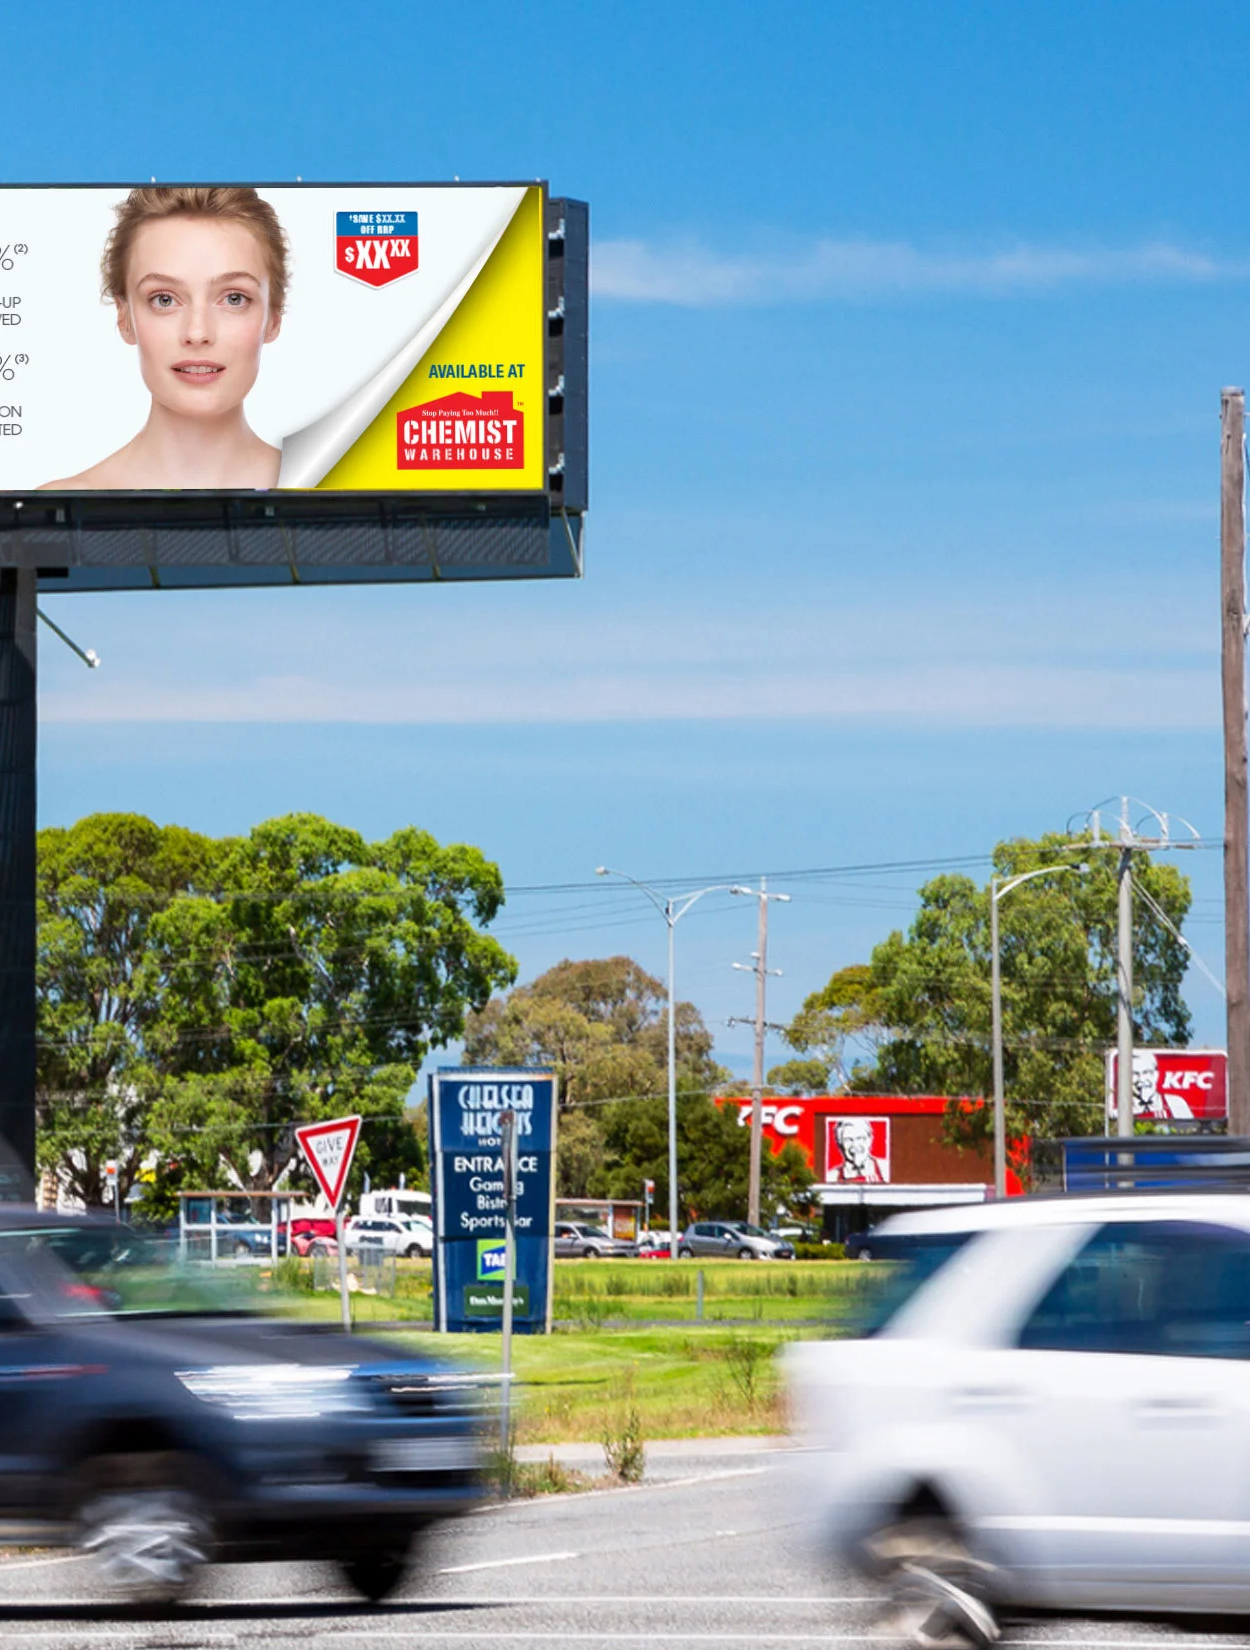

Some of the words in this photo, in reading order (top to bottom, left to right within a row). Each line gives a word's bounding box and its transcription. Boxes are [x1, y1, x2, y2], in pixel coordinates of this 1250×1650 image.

[360, 225, 375, 234] OFF
[377, 225, 395, 234] RRP
[428, 364, 504, 379] AVAILABLE
[507, 364, 526, 378] AT
[421, 409, 437, 417] Stop
[438, 409, 461, 417] Paying
[403, 419, 517, 445] CHEMIST
[404, 448, 514, 461] WAREHOUSE
[1161, 1070, 1215, 1090] KFC
[458, 1084, 533, 1110] CHELSEA
[315, 1136, 343, 1154] GIVE
[453, 1156, 538, 1173] ENTRACE
[469, 1176, 524, 1196] Gamg
[476, 1194, 508, 1210] Bistr
[460, 1211, 506, 1232] Sports
